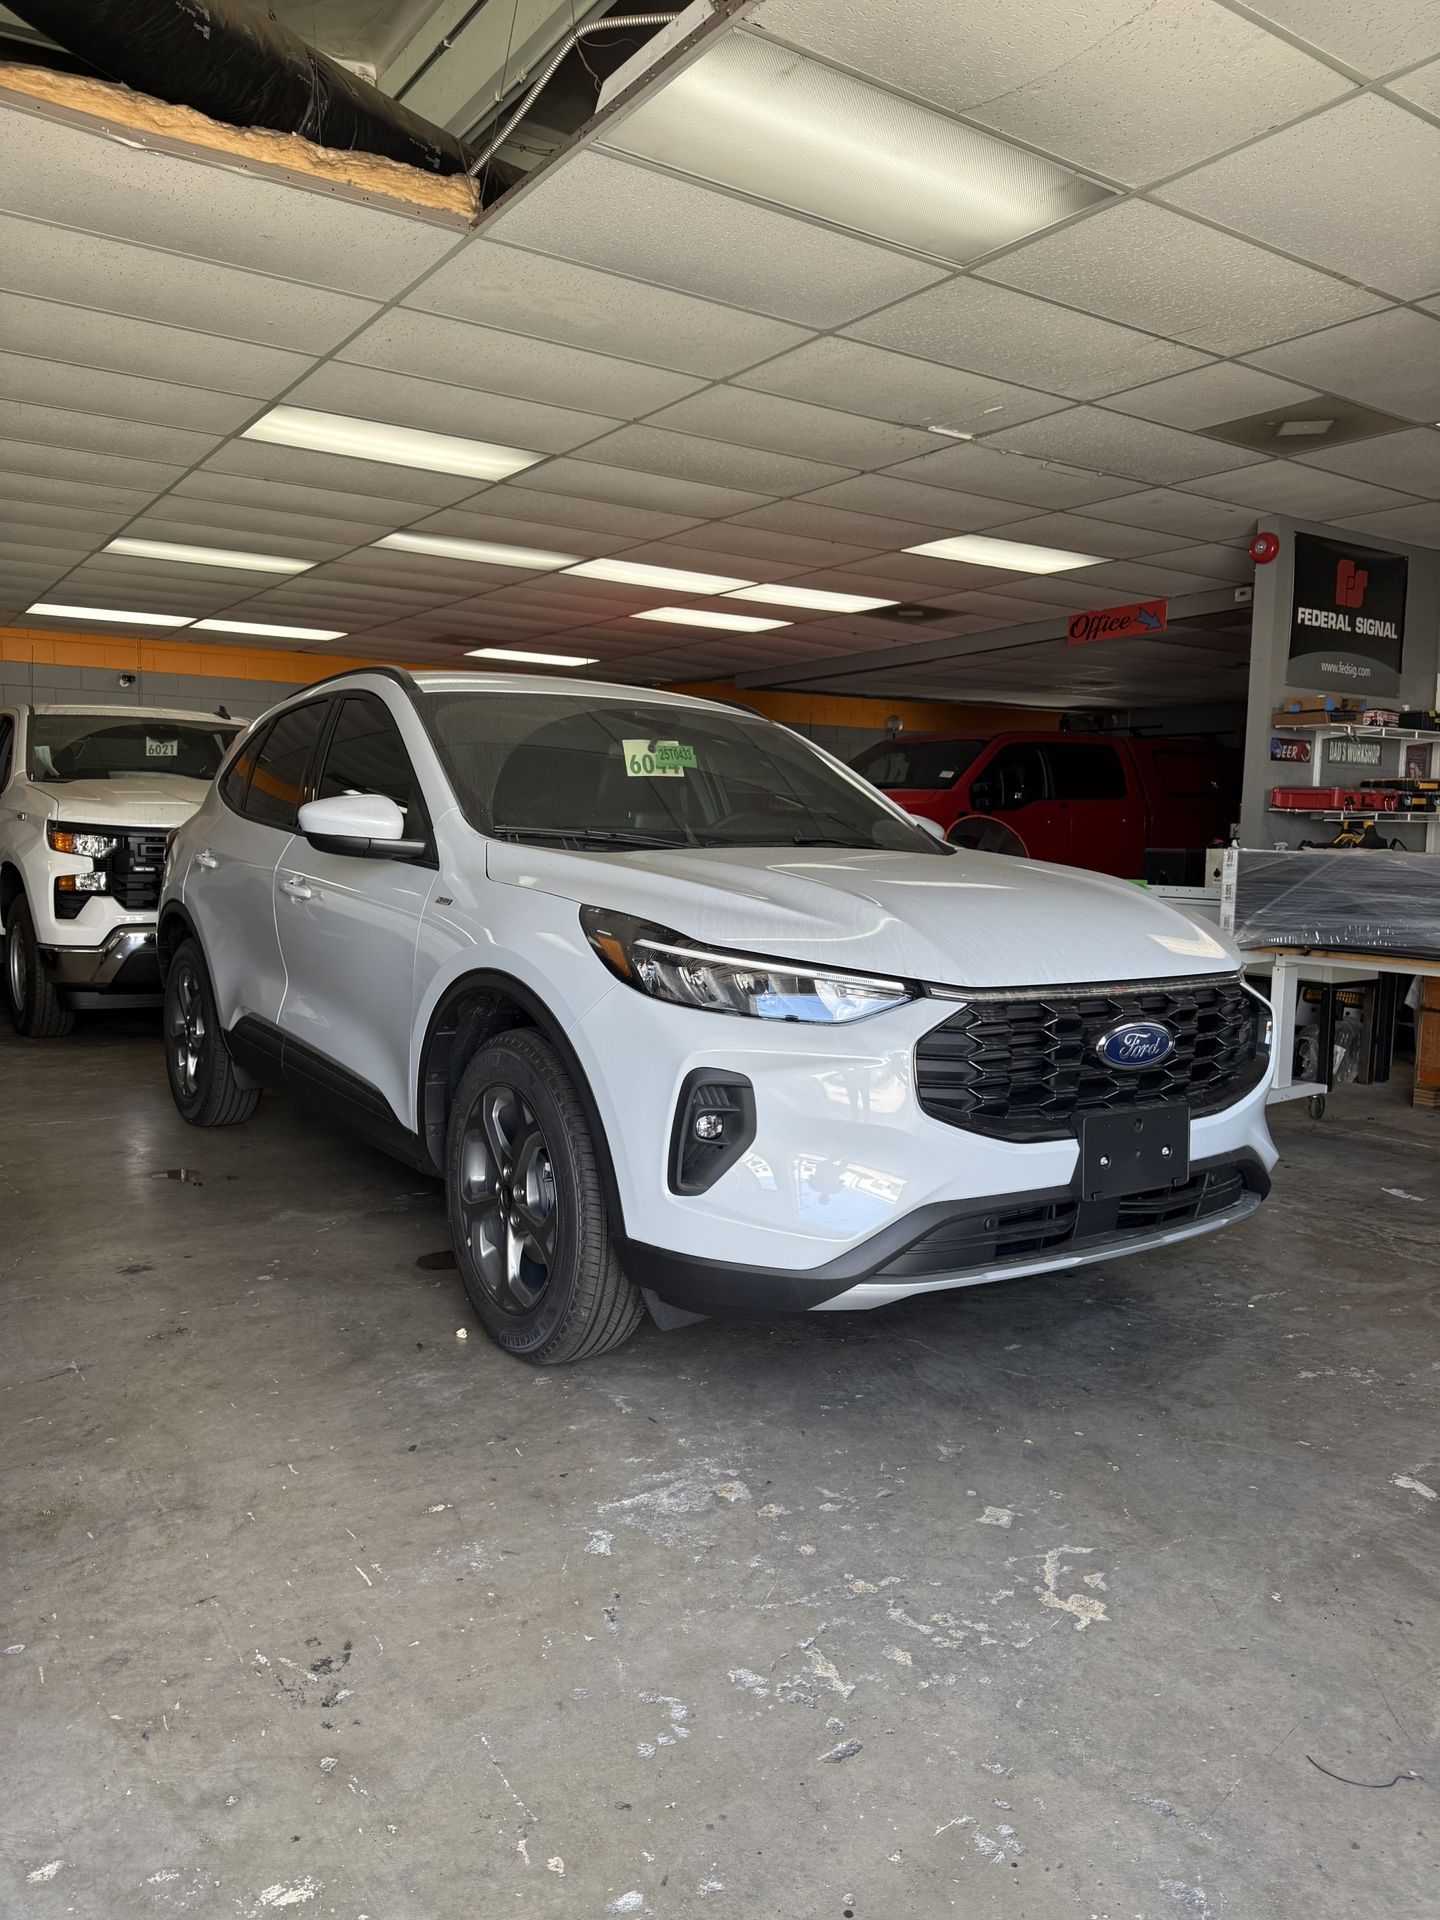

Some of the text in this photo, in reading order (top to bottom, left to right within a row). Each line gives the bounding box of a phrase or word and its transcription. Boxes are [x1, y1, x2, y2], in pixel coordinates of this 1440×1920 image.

[1070, 615, 1132, 641] Office
[1297, 607, 1398, 639] FEDERAL SIGNAL
[1321, 660, 1371, 678] www.fedsig.com
[148, 743, 175, 755] 6021
[1329, 741, 1381, 764] DAD'S WORKSHOP
[1119, 1032, 1160, 1059] Ford
